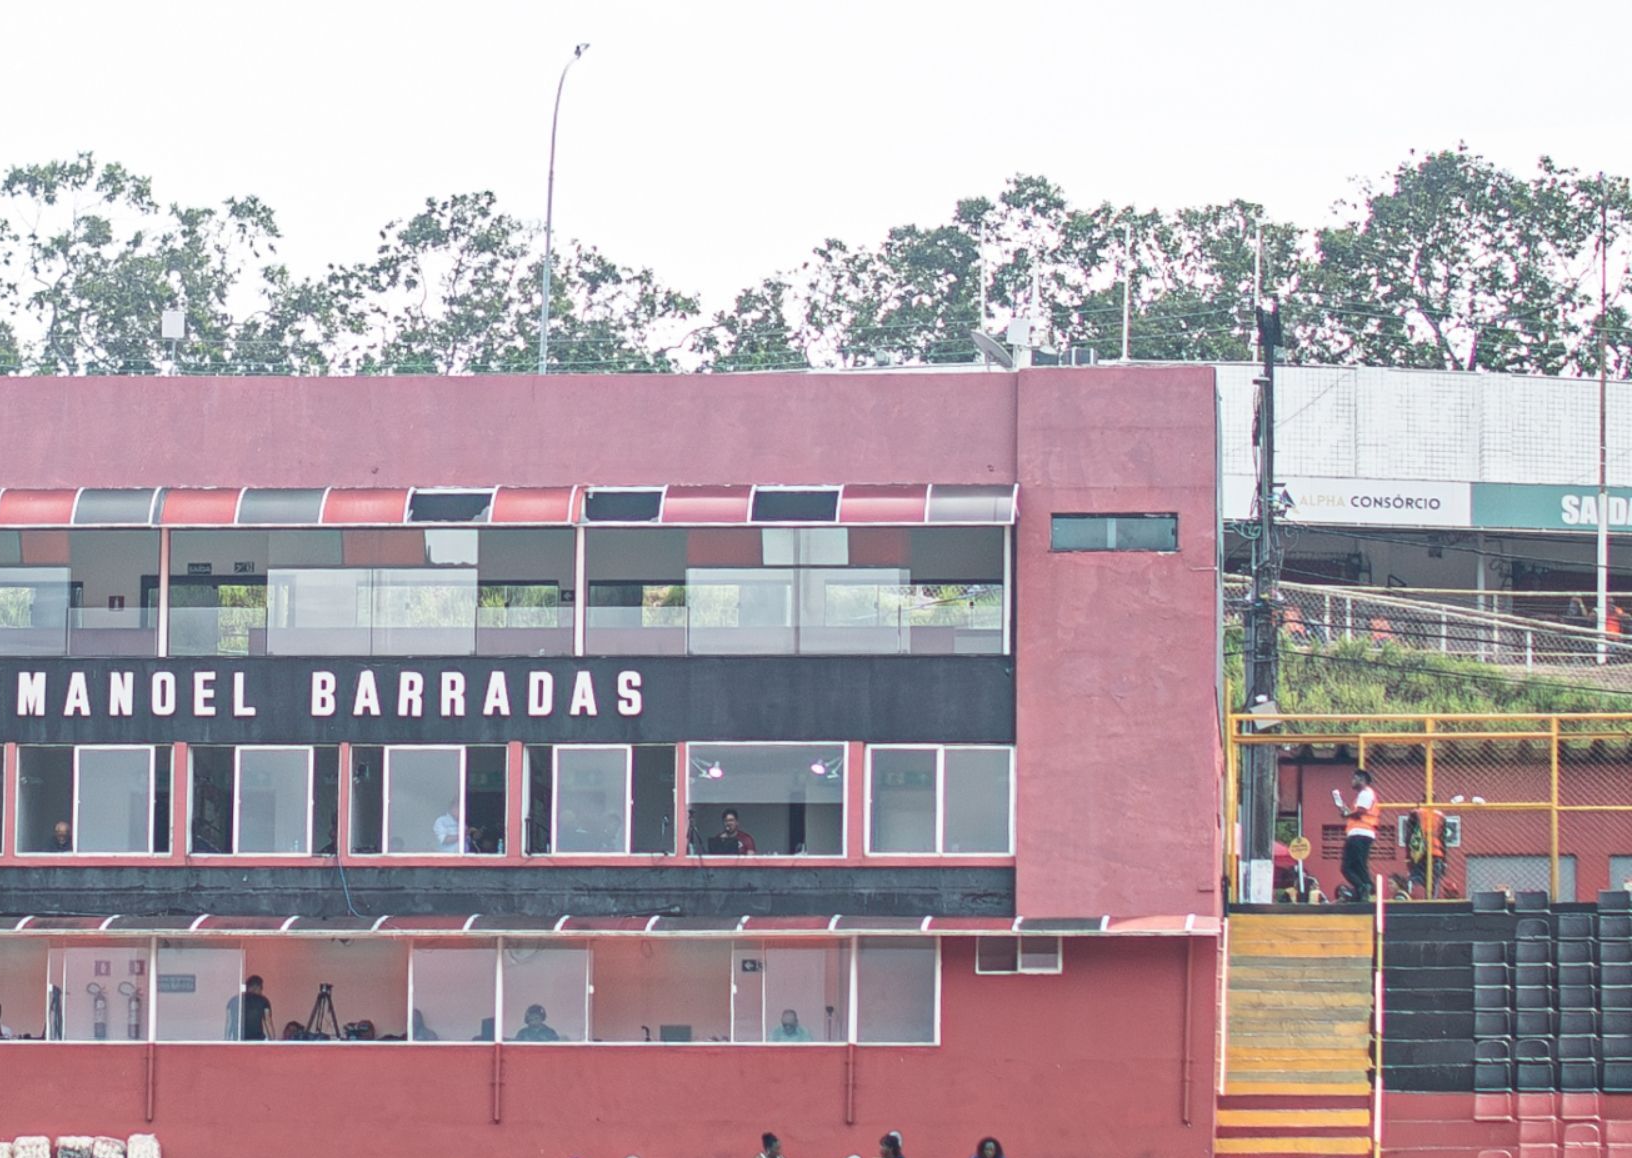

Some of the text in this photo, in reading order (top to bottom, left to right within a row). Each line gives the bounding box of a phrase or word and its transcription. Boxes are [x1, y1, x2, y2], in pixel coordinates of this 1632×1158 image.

[1300, 493, 1441, 510] ALPHA CONSÓRCIO
[1561, 494, 1632, 526] SAD
[16, 670, 257, 717] MANOEL
[311, 669, 643, 717] BARRADAS
